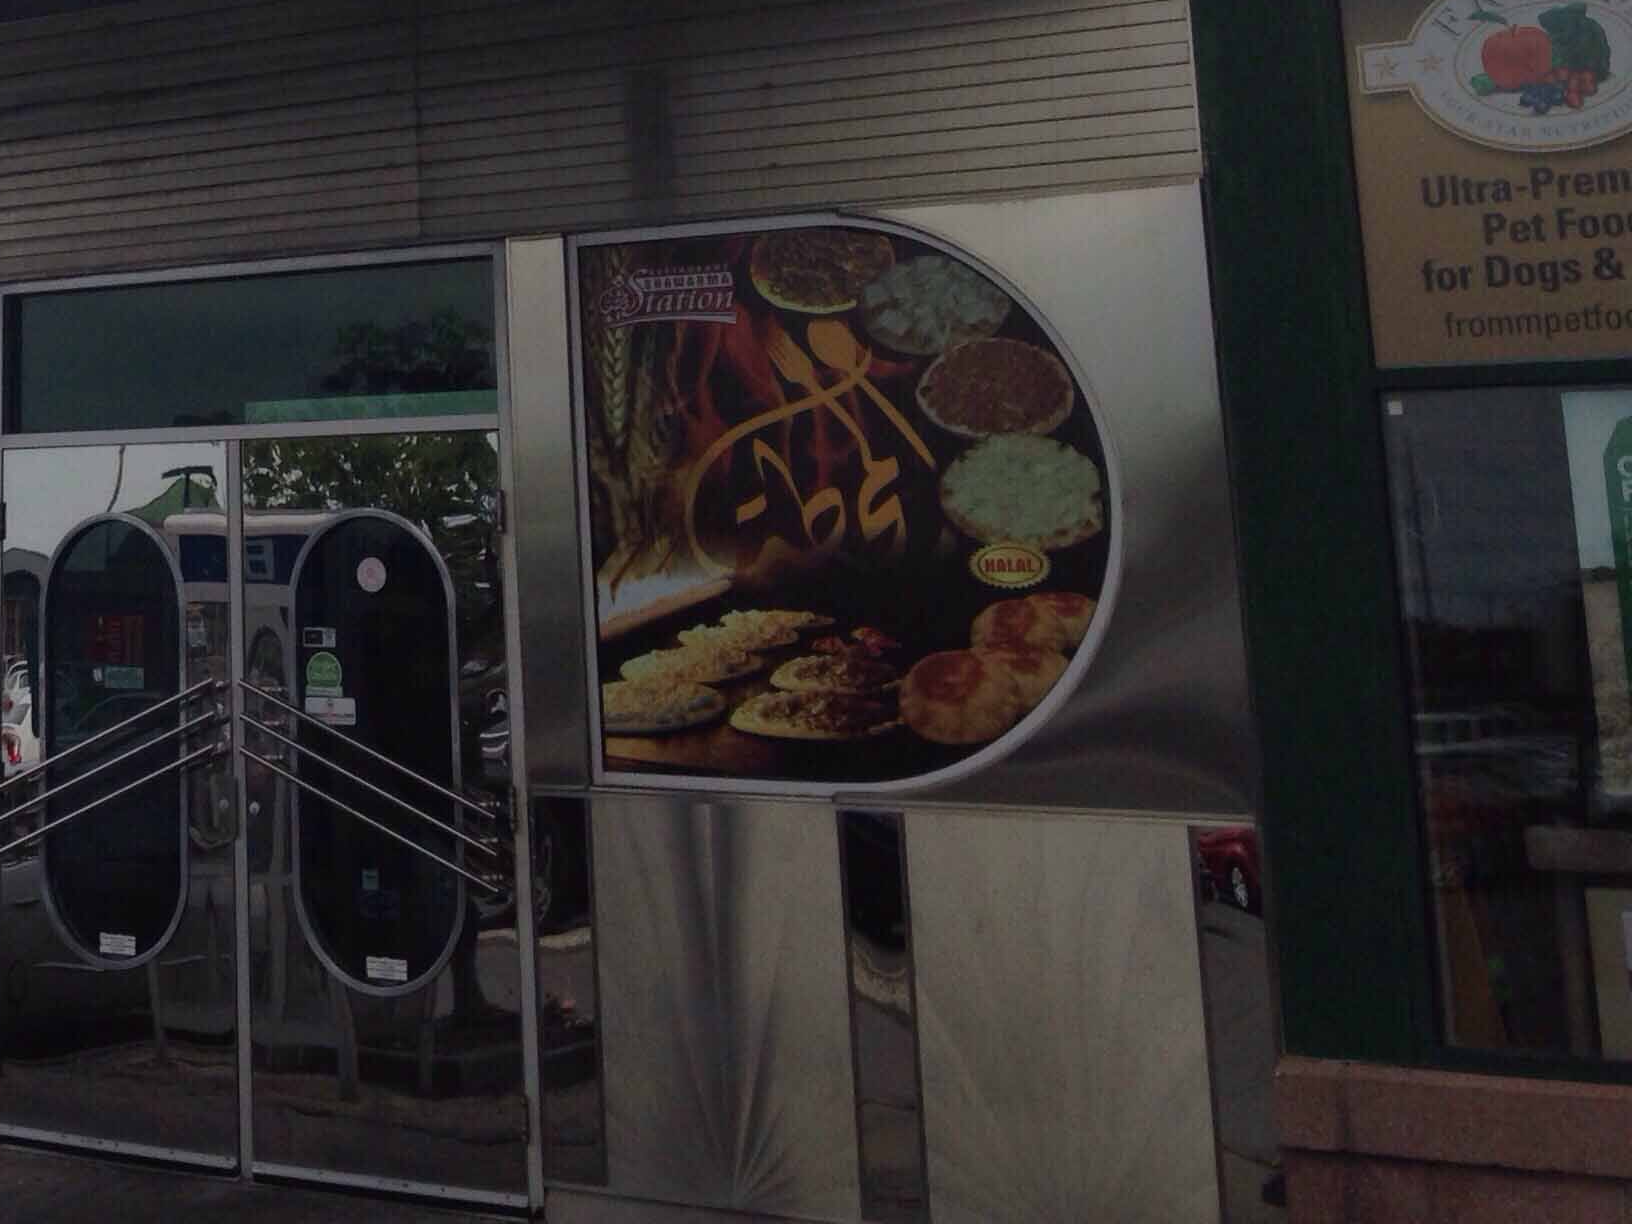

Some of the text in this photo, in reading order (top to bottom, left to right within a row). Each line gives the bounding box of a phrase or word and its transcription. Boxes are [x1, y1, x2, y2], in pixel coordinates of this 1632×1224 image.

[1482, 207, 1632, 248] Pet Foo
[1422, 247, 1625, 293] for Dogs &
[984, 554, 1036, 574] HALAL
